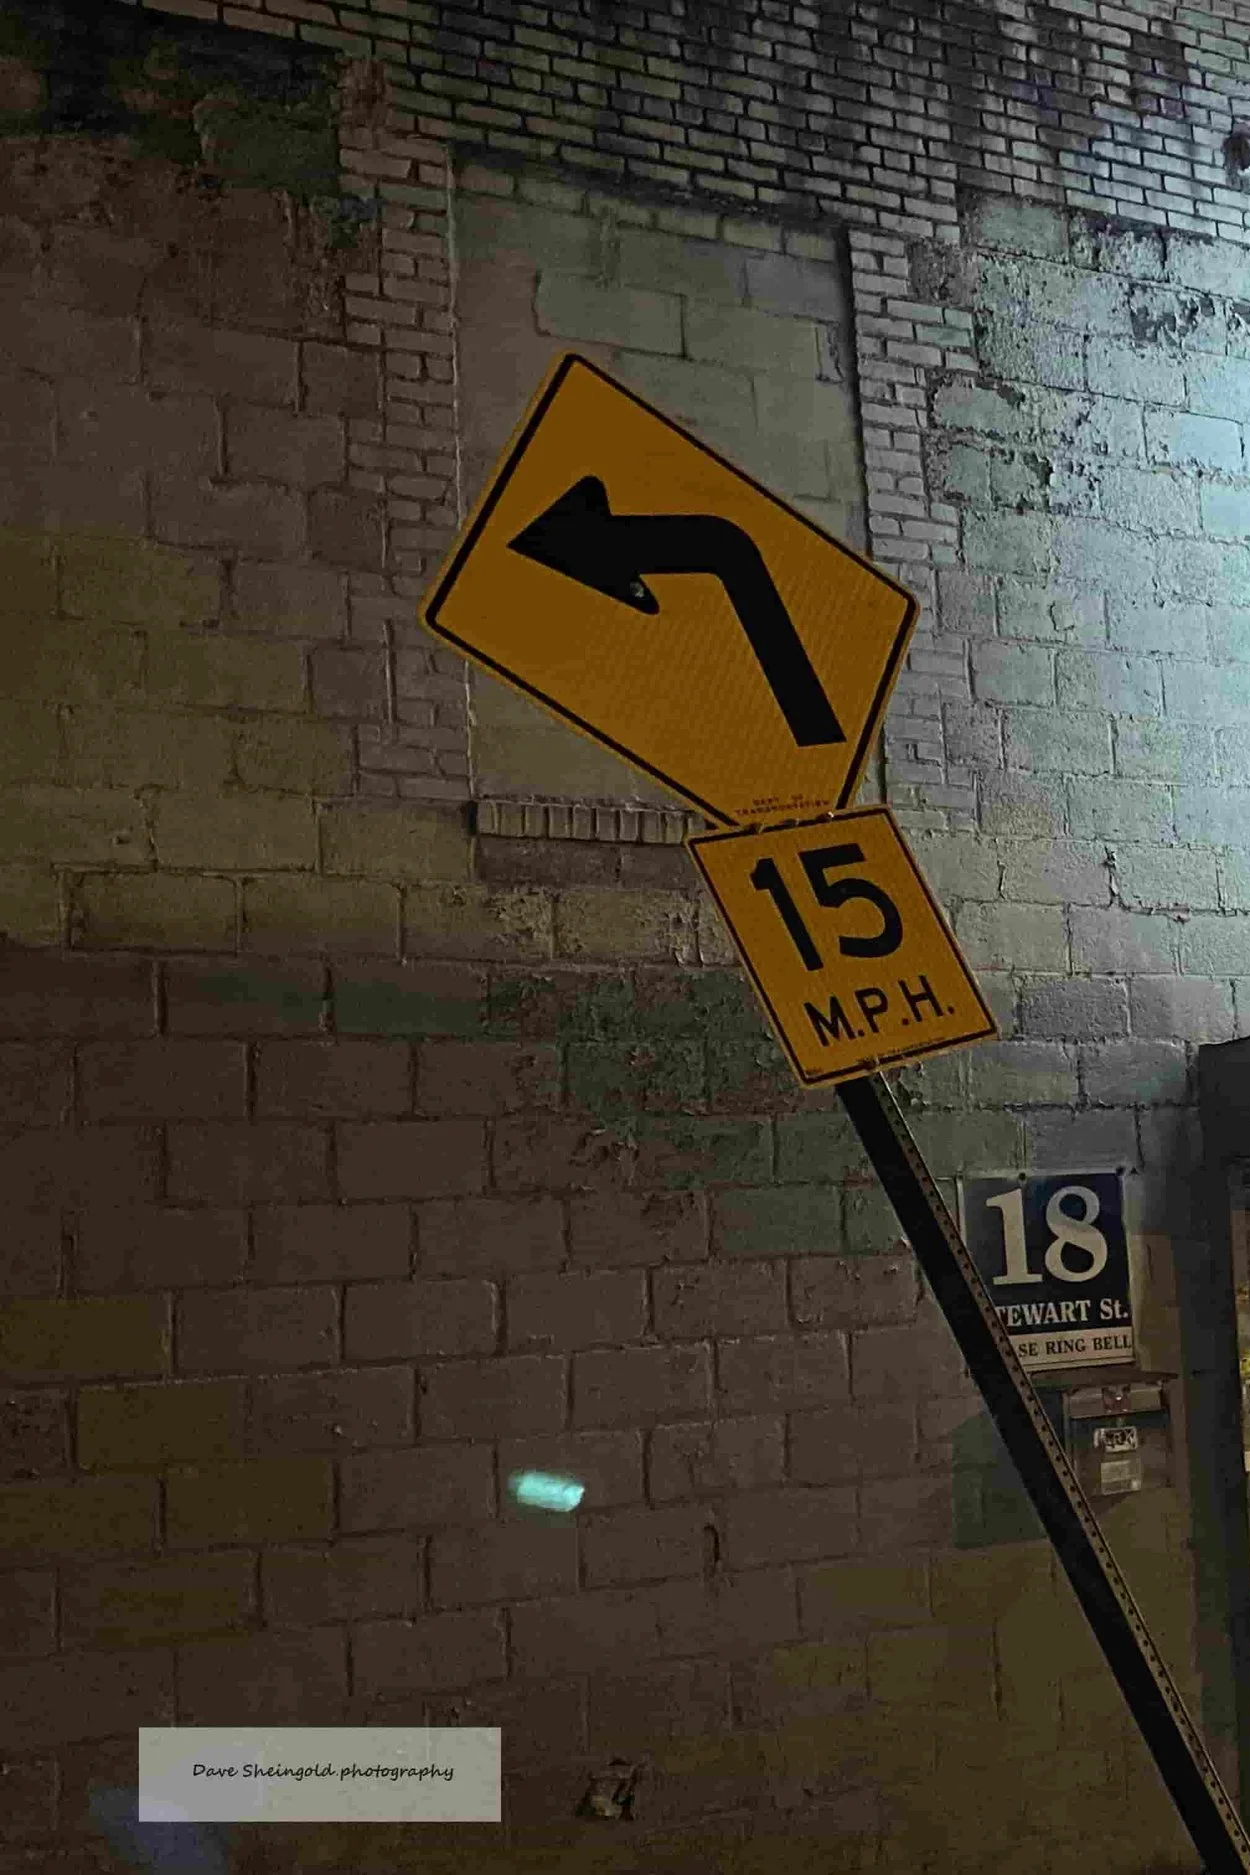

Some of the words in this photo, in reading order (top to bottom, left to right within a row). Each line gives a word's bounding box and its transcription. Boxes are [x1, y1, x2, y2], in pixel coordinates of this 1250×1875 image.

[750, 843, 903, 972] 15
[803, 975, 955, 1047] M.P.H.
[985, 1185, 1108, 1286] 18
[995, 1299, 1092, 1327] TEWART
[1099, 1298, 1129, 1320] St.
[1045, 1338, 1086, 1355] RING
[1093, 1334, 1132, 1351] BELL
